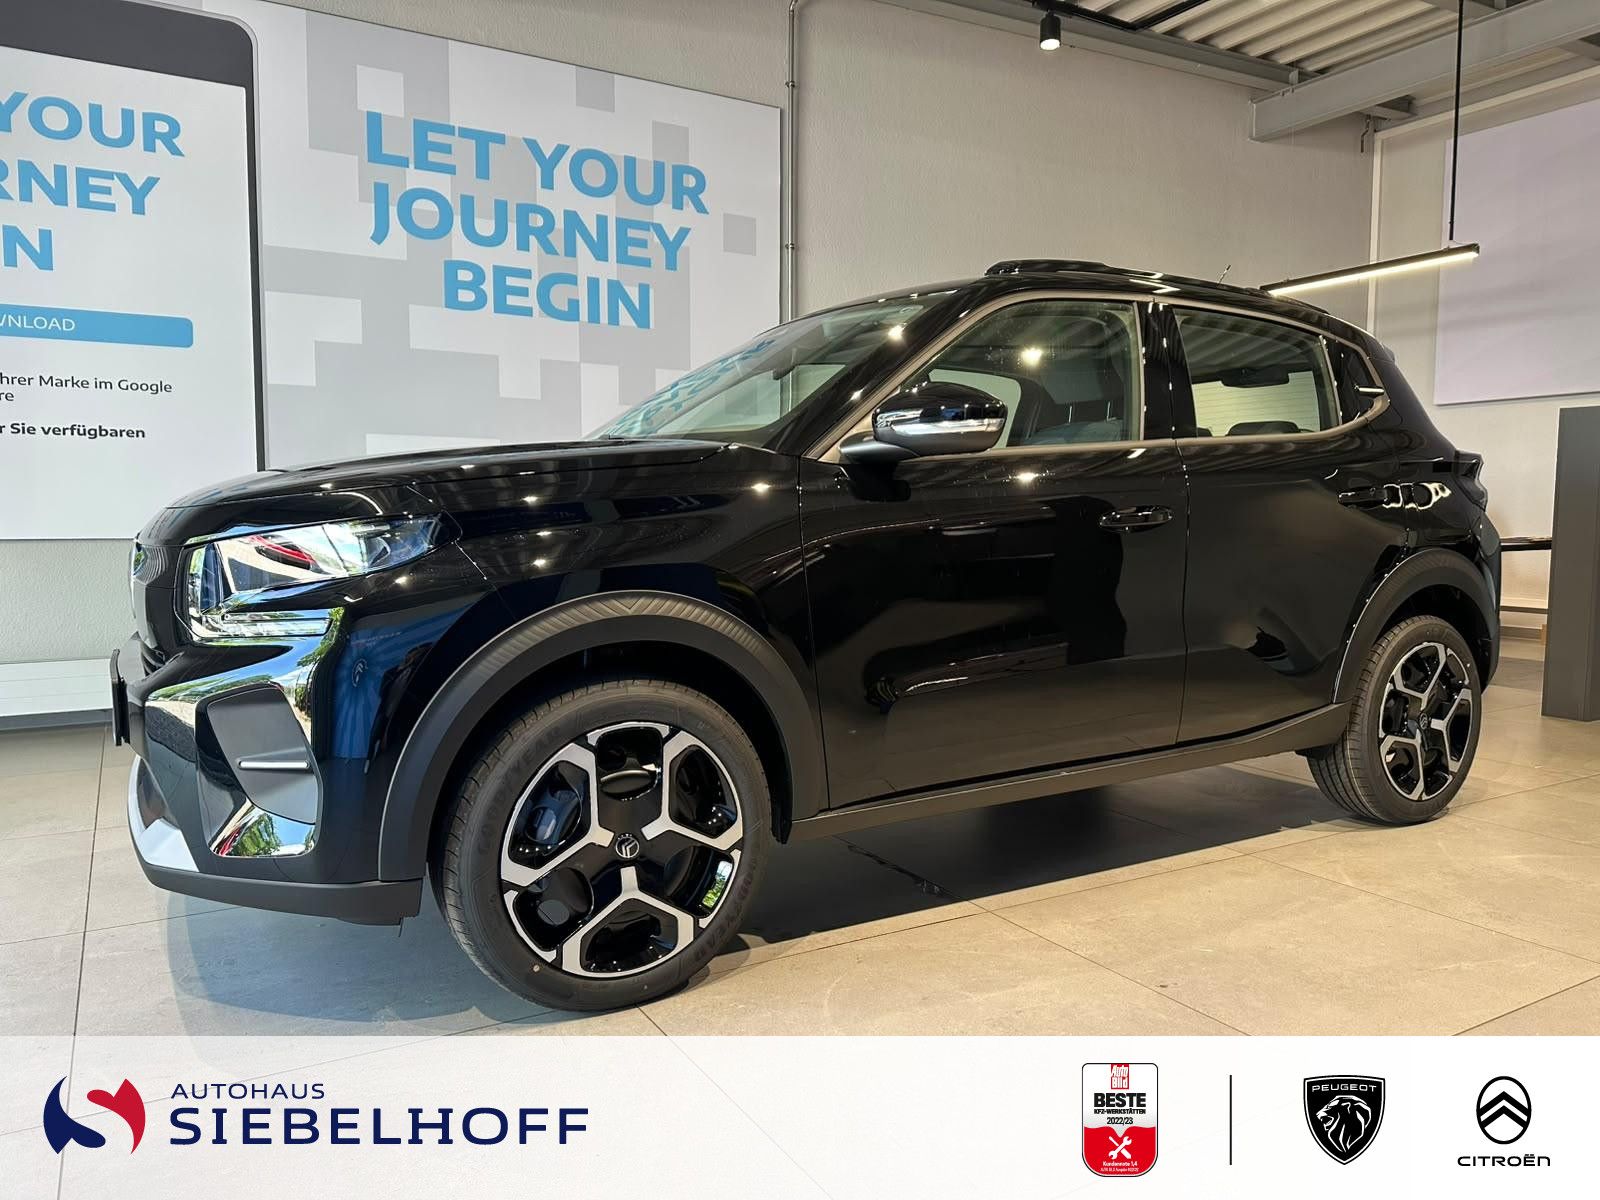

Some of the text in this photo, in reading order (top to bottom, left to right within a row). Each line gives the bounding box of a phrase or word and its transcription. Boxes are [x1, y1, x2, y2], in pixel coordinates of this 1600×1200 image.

[366, 110, 709, 215] LET YOUR
[370, 181, 692, 271] JOURNEY
[443, 259, 651, 329] BEGIN
[0, 371, 173, 395] hrer Marke im Google
[10, 422, 36, 435] Sie
[40, 423, 146, 440] verfügbaren
